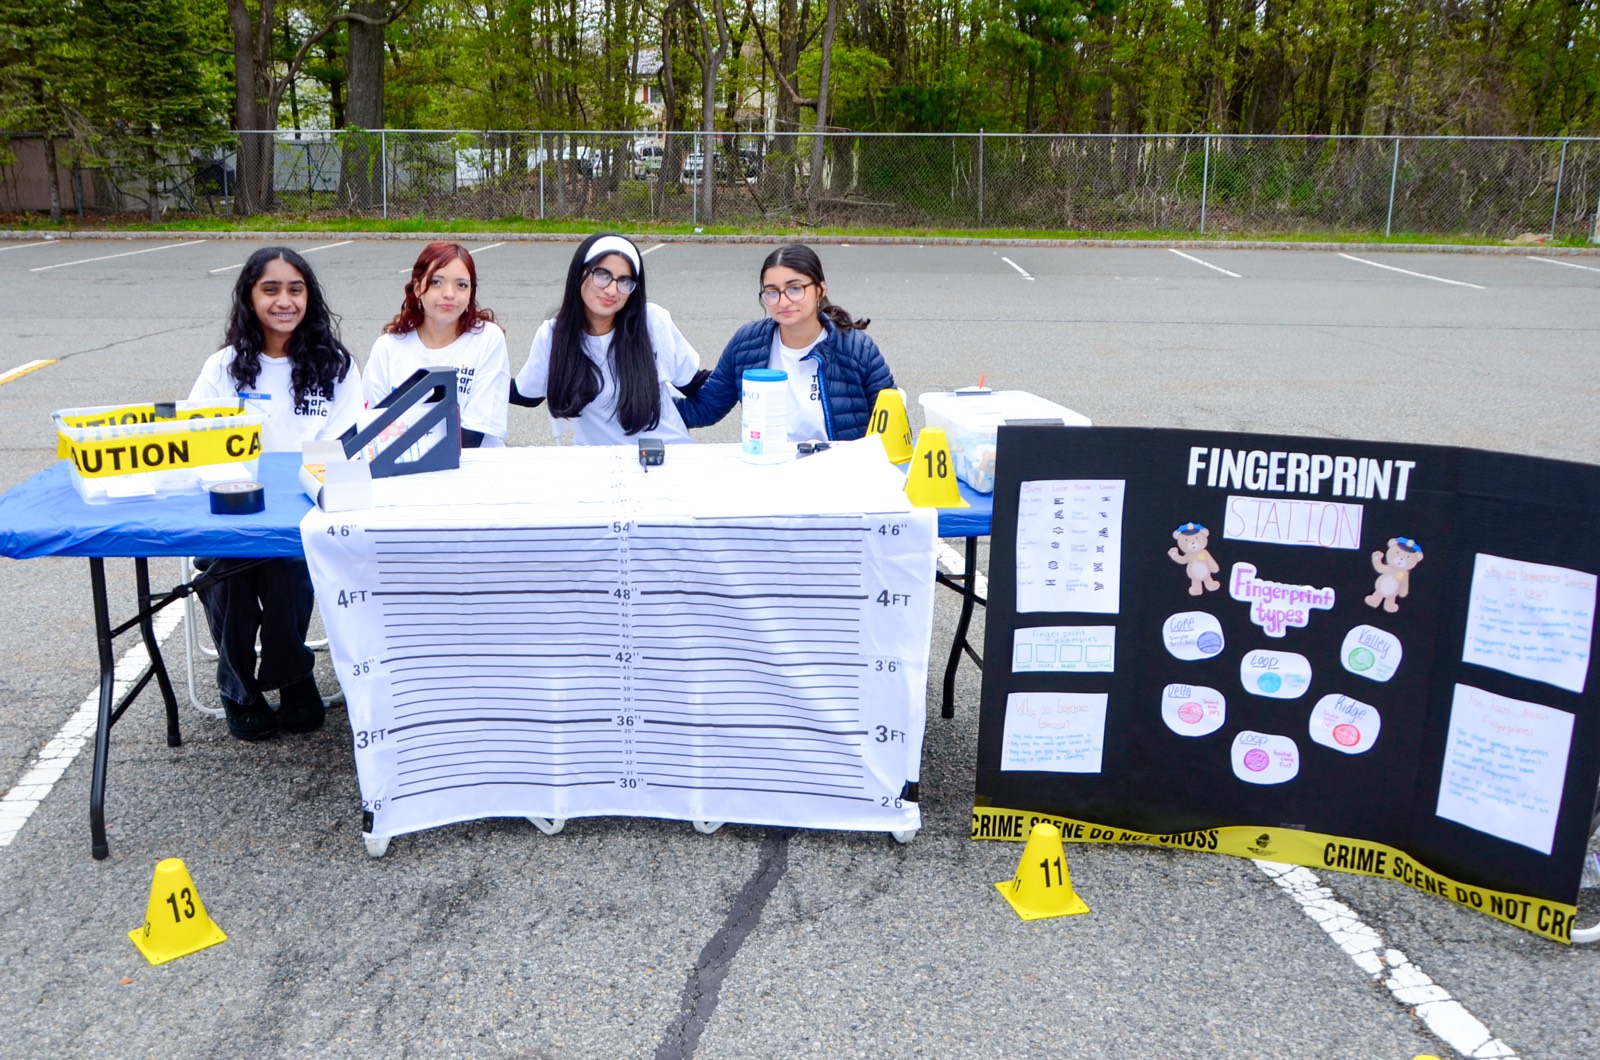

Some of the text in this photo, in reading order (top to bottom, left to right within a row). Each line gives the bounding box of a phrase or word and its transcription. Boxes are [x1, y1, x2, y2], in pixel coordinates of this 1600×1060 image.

[871, 408, 889, 434] 10
[924, 450, 948, 478] 18
[1187, 447, 1416, 501] FINGERPRINT
[1227, 498, 1361, 549] STATION
[1234, 568, 1333, 605] Fingerprint
[1170, 617, 1195, 632] Core
[1256, 605, 1304, 633] types
[1357, 628, 1391, 659] Valley
[1250, 654, 1279, 669] Loop
[1168, 684, 1191, 698] Delta
[1334, 695, 1366, 723] Ridge
[1239, 732, 1269, 746] Loop
[971, 815, 1024, 838] CRIME
[1029, 816, 1083, 839] SENE
[1089, 826, 1115, 841] DO
[1040, 856, 1063, 888] 11
[1324, 842, 1388, 876] CRIME
[1393, 856, 1449, 898] SCENE
[1456, 886, 1483, 908] DO
[1490, 895, 1531, 925] NOT
[166, 887, 195, 923] 13
